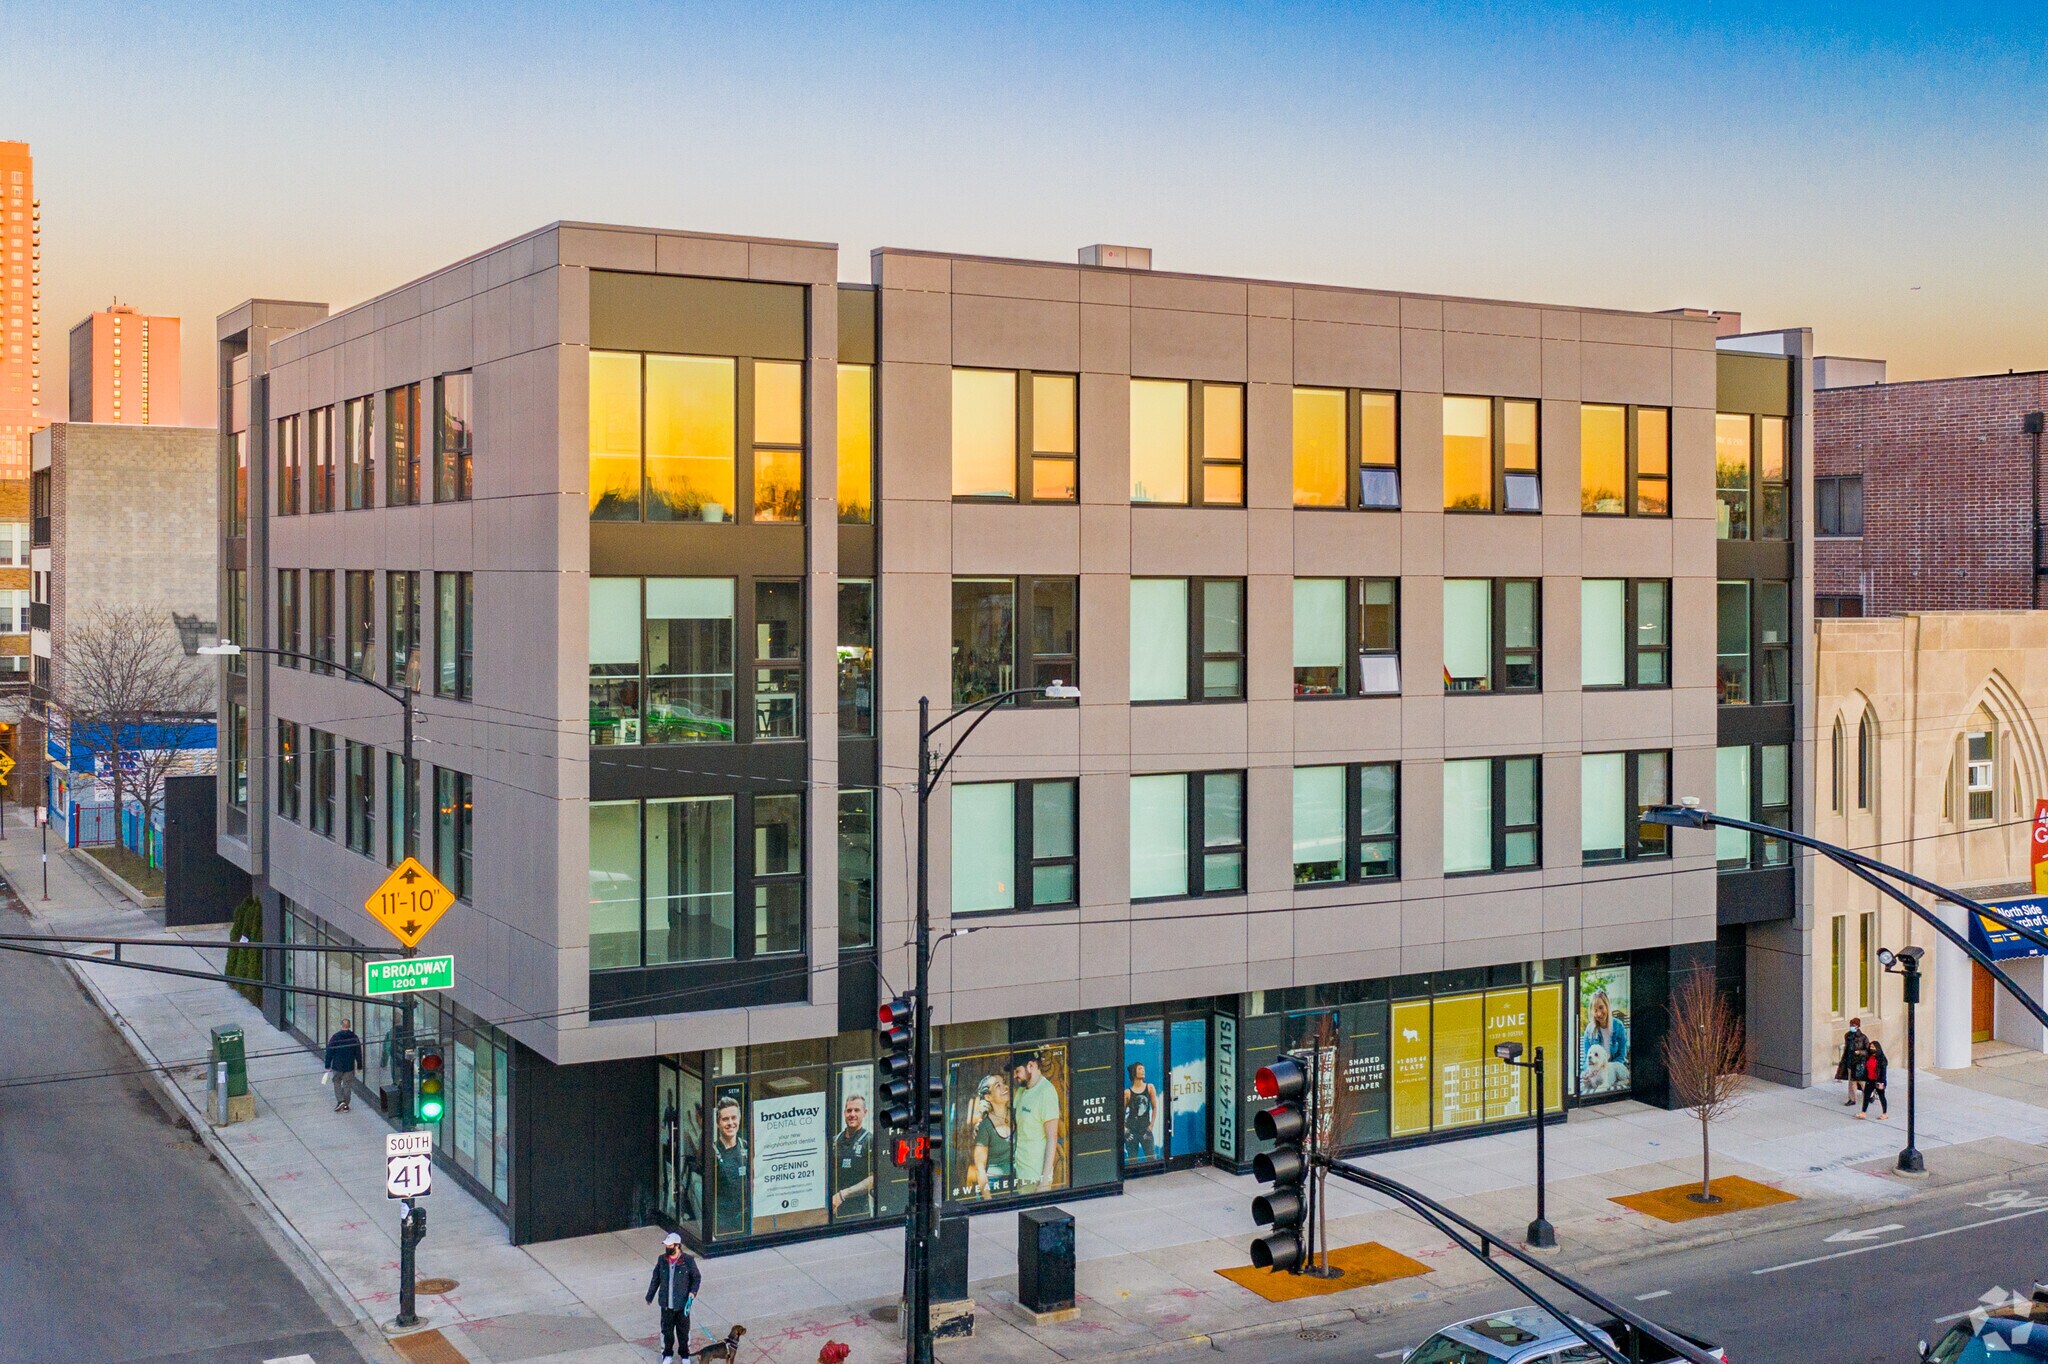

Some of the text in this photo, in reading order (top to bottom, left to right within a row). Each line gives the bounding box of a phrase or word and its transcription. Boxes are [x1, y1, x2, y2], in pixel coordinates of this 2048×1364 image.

[381, 889, 440, 915] 11'-10"
[1996, 904, 2043, 918] North Side
[2032, 915, 2043, 926] of
[371, 960, 449, 979] N BROADWAY
[392, 976, 429, 989] 1200 W
[1487, 1012, 1526, 1030] JUNE
[1348, 1056, 1380, 1066] SHARED
[1343, 1063, 1386, 1076] AMENITIES
[1345, 1072, 1383, 1084] WITH THE
[1172, 1081, 1203, 1095] FLATS
[1348, 1081, 1380, 1092] DRAPER
[1082, 1096, 1107, 1106] MEET
[760, 1106, 820, 1122] broadway
[1084, 1107, 1104, 1115] OUR
[767, 1119, 797, 1131] DENTAL
[1077, 1114, 1112, 1125] PEOPLE
[390, 1136, 430, 1151] SOUTH
[771, 1160, 809, 1173] OPENING
[393, 1164, 421, 1188] 41
[763, 1169, 816, 1183] SPRING 2021
